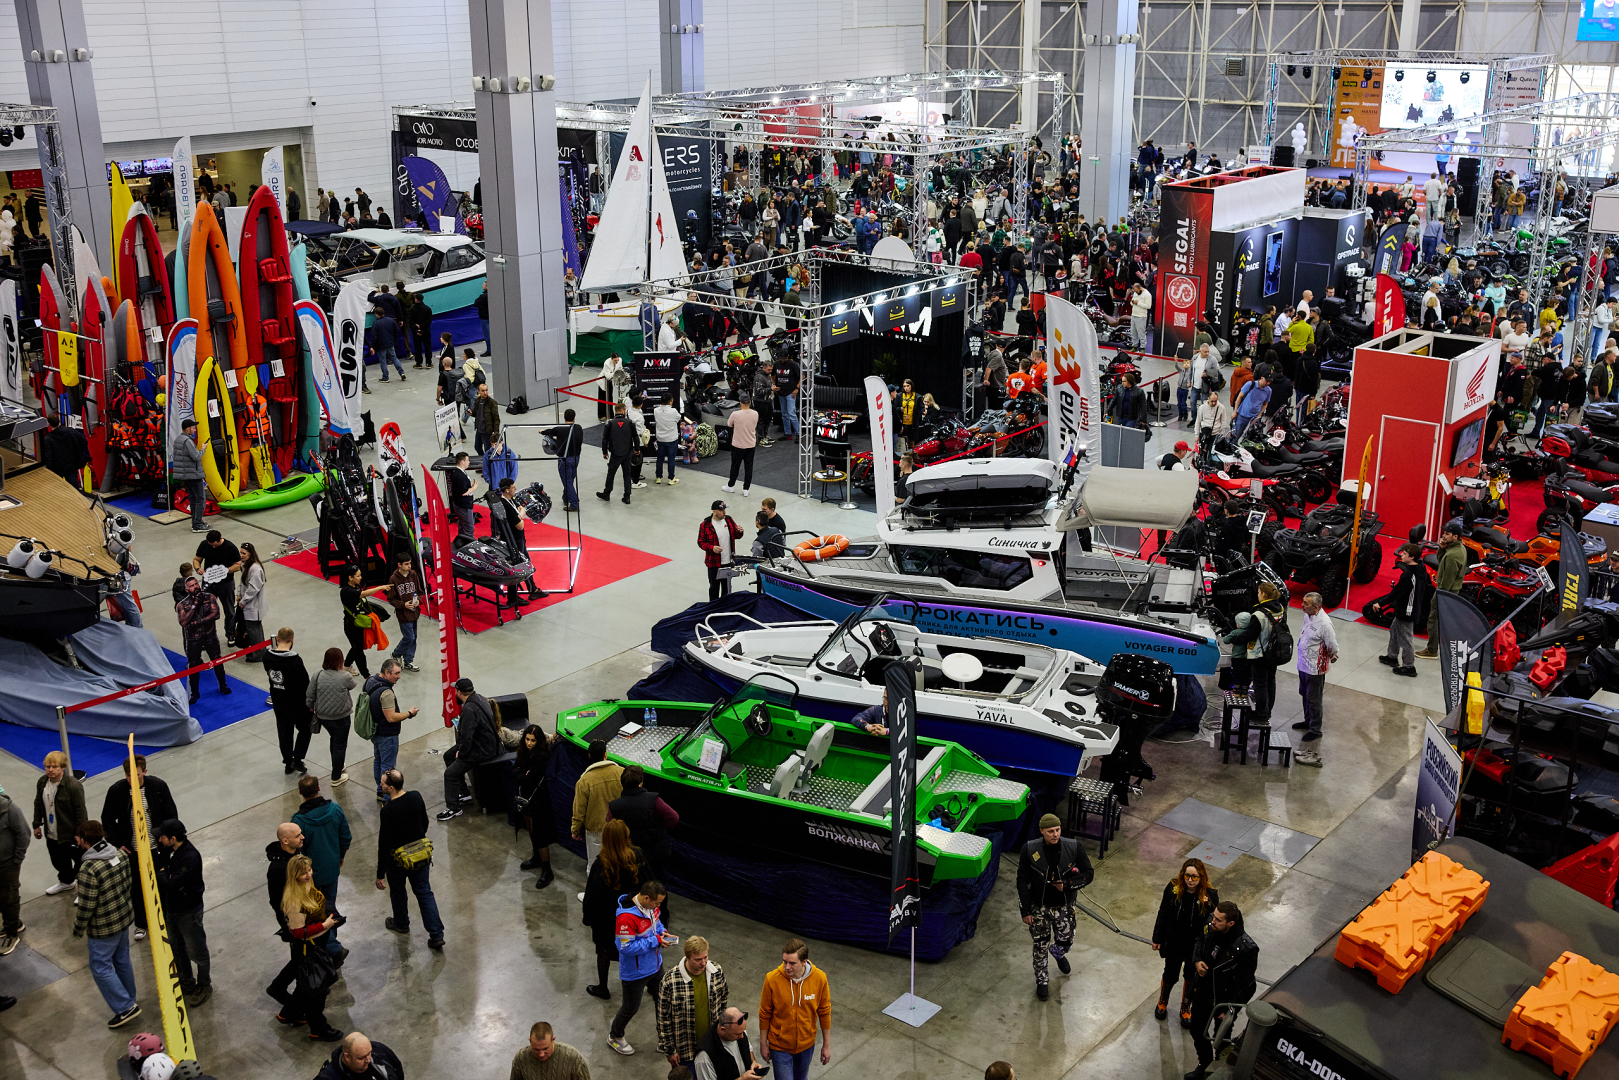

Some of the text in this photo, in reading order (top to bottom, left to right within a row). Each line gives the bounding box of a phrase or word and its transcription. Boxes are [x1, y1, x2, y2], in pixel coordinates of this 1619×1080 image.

[664, 145, 700, 167] ERS
[1174, 217, 1190, 274] SEGAL
[1189, 219, 1197, 256] LUBRICANTS
[1337, 247, 1360, 260] GPSTRADE
[895, 334, 923, 343] MOTORS
[340, 321, 357, 398] RST
[643, 358, 671, 368] NXM
[1463, 393, 1485, 410] HONDA
[816, 426, 838, 439] NXM
[988, 536, 1039, 549] Синичка
[1073, 569, 1139, 580] VOYAGER
[903, 603, 1045, 631] ПРОКАТИСЬ
[914, 619, 1037, 639] ЕХНИКА ДЛЯ АКТИВНОГО ОТДЫХА
[1124, 641, 1198, 656] VOYAGER 600
[808, 826, 881, 851] ВОЛЖАНКА
